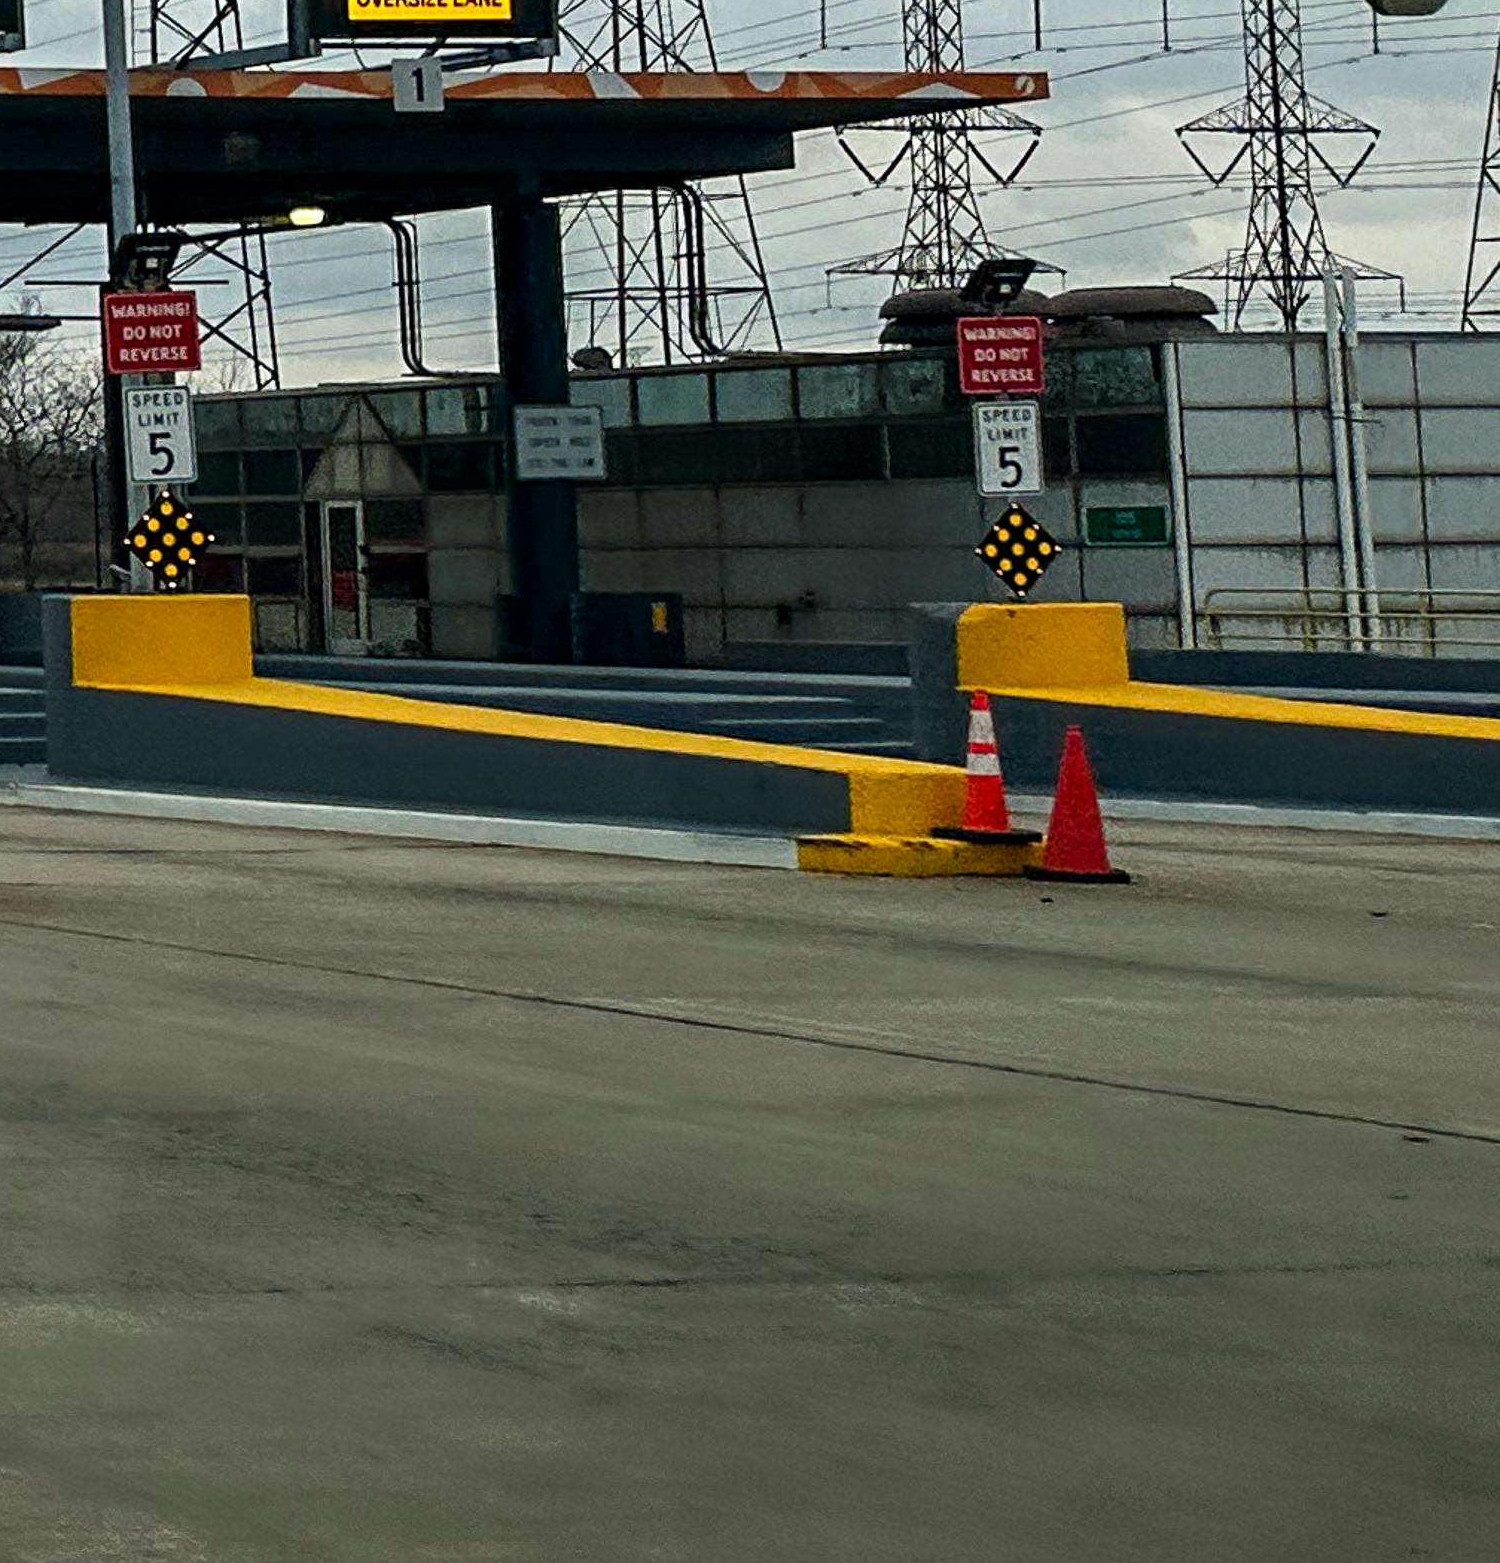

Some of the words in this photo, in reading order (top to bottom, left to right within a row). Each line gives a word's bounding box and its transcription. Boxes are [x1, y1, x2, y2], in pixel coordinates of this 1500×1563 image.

[411, 67, 425, 103] 1
[110, 302, 191, 319] WARNING!
[122, 326, 146, 341] DO
[150, 324, 183, 340] NOT
[119, 346, 189, 363] REVERSE
[973, 348, 996, 363] DO
[999, 347, 1030, 362] NOT
[971, 368, 1035, 383] REVERSE
[132, 392, 184, 408] SPEED
[137, 411, 181, 428] LIMIT
[982, 408, 1032, 424] SPEED
[987, 426, 1029, 442] LIMIT
[149, 431, 175, 476] 5
[998, 445, 1023, 489] 5
